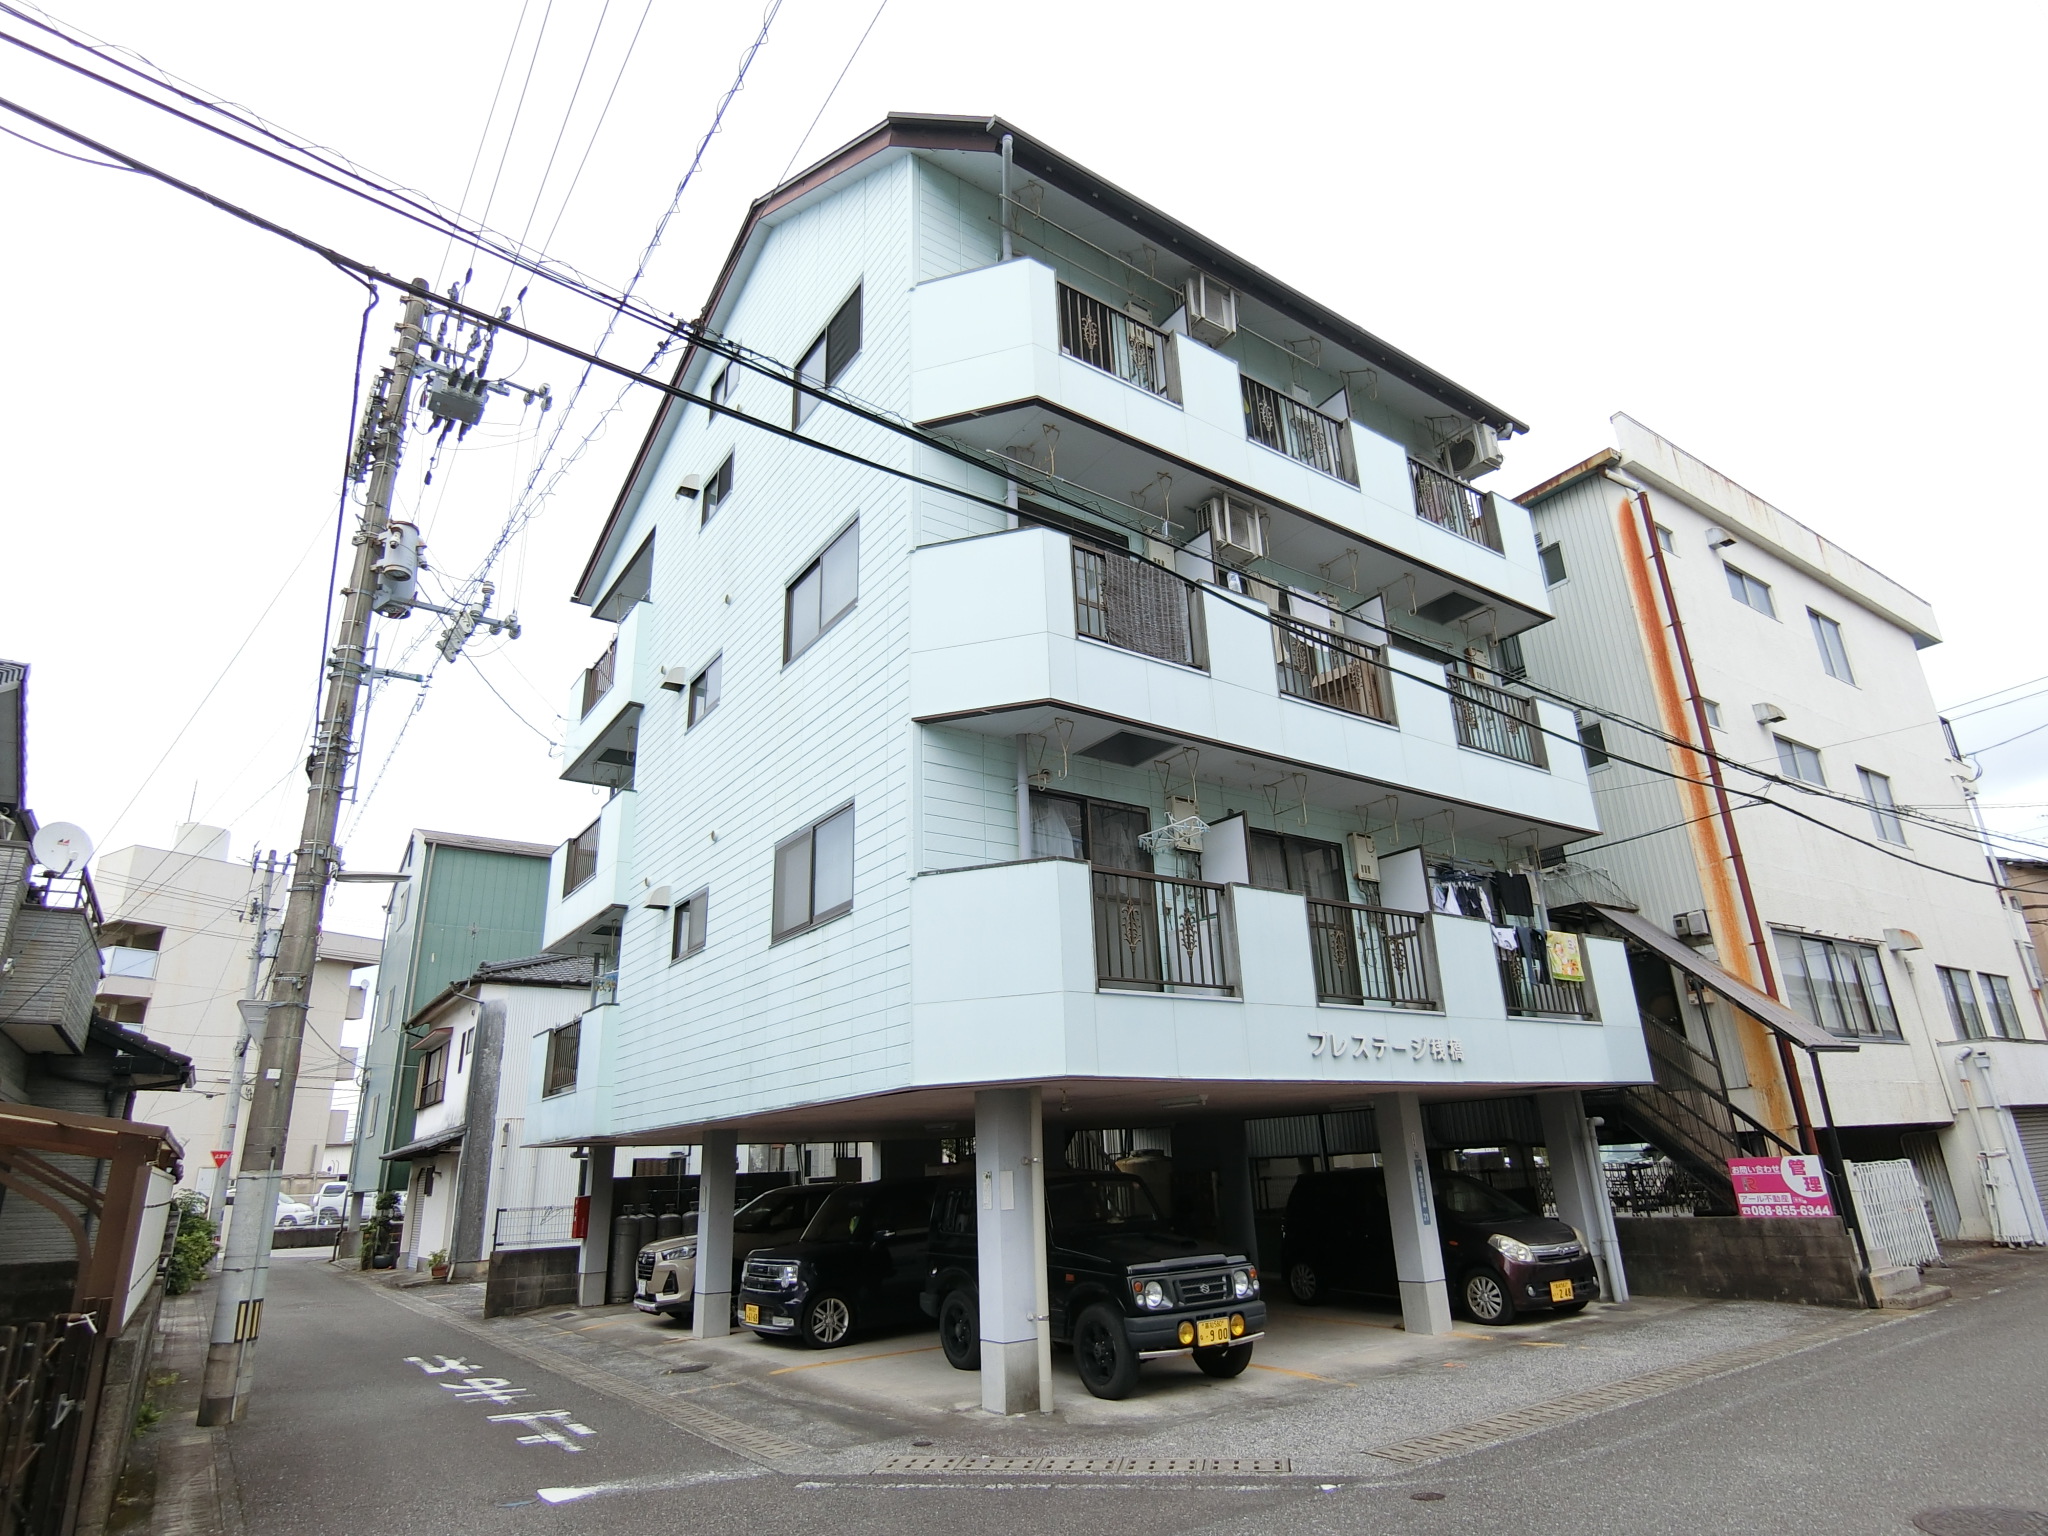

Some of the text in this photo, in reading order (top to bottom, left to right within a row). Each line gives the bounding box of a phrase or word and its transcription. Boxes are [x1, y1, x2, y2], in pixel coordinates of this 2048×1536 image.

[1731, 1165, 1780, 1174] お問い合わせ
[1751, 1205, 1830, 1216] 088-855-6344
